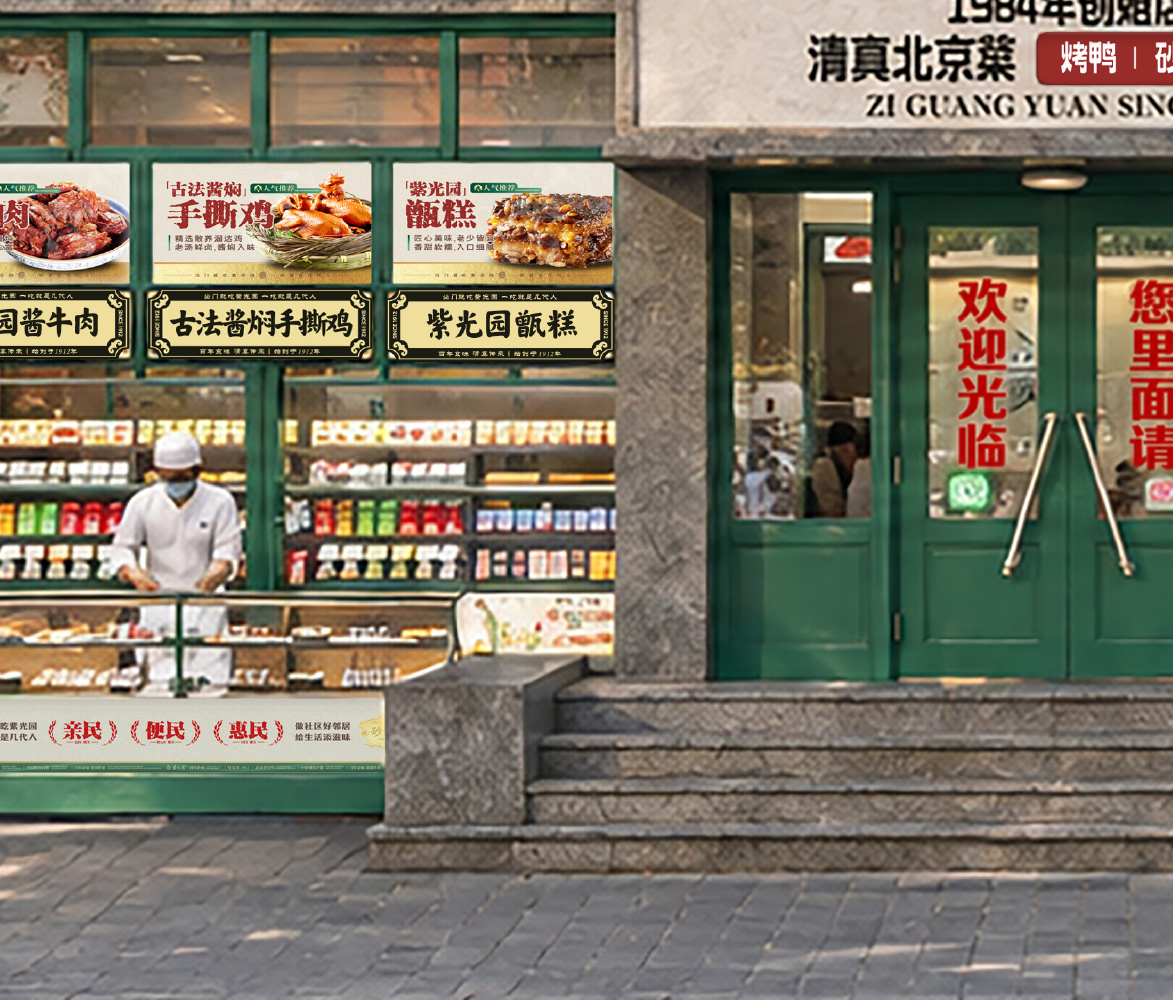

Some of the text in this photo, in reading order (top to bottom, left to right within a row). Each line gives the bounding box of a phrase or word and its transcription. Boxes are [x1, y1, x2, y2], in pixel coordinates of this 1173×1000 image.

[808, 34, 1016, 83] 清真北京菜
[1061, 41, 1116, 73] 烤鸭
[867, 94, 895, 117] ZI
[906, 94, 1014, 118] GUANG
[1024, 94, 1108, 118] YUAN
[168, 199, 274, 229] 手撕鸡
[406, 199, 476, 228] 甑糕
[0, 307, 98, 337] 园酱牛肉
[170, 309, 353, 337] 古法酱焖手撕鸡
[427, 308, 577, 340] 紫光园甑糕
[958, 278, 1007, 468] 欢迎光临
[0, 721, 38, 731] 吃紫光园
[0, 732, 38, 742] 是几代人
[63, 721, 102, 740] 亲民
[146, 721, 184, 740] 便民
[229, 721, 268, 740] 惠民
[295, 722, 350, 730] 做社区好邻居
[295, 733, 350, 741] 给生活添滋味
